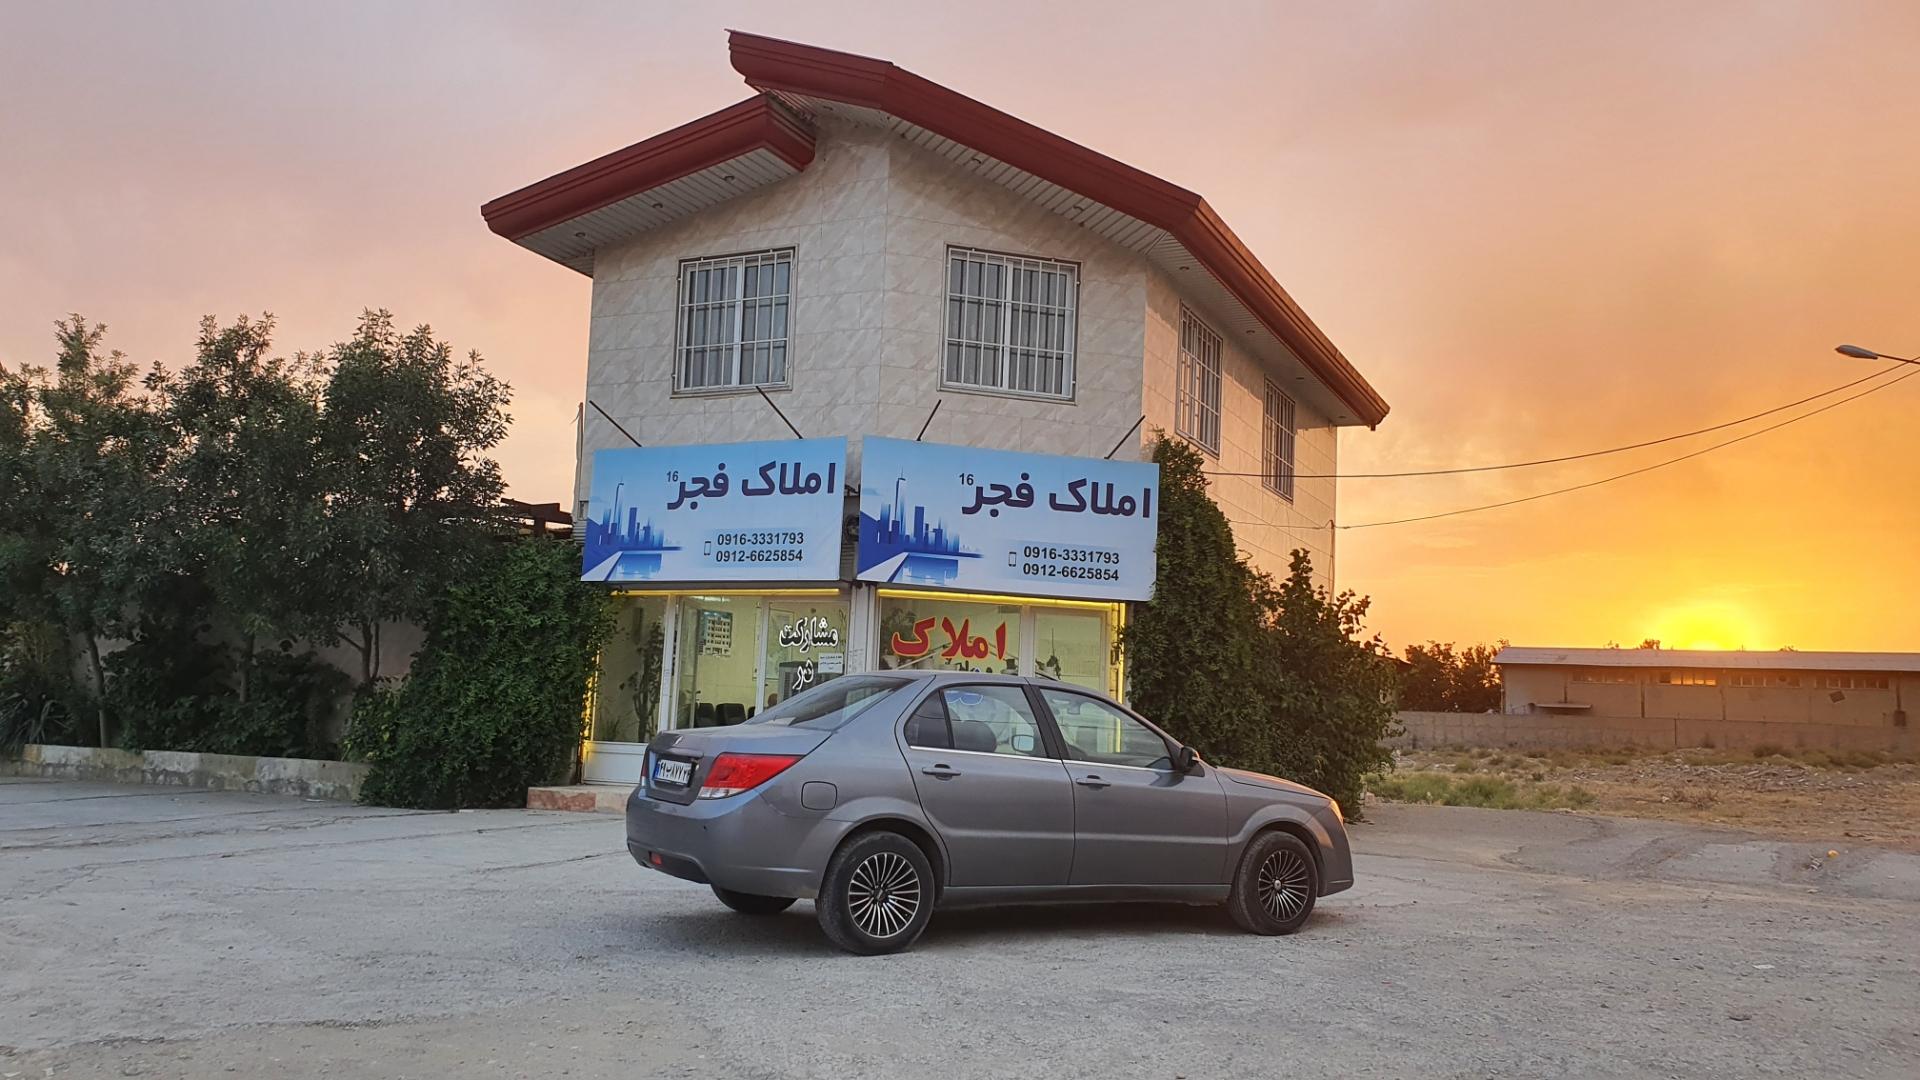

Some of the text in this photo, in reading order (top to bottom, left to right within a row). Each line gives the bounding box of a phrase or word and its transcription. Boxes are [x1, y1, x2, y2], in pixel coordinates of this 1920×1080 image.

[666, 470, 679, 483] 16
[667, 461, 836, 510] املاک فجر
[959, 473, 975, 486] 16
[961, 472, 1151, 518] املاک فجر
[717, 532, 804, 546] 0916-3331793
[715, 548, 804, 563] 0912-6625854
[1023, 546, 1120, 565] 0916-3331793
[1022, 563, 1120, 582] 0912-6625854
[779, 616, 839, 653] مشارکت
[891, 616, 1007, 660] املاک
